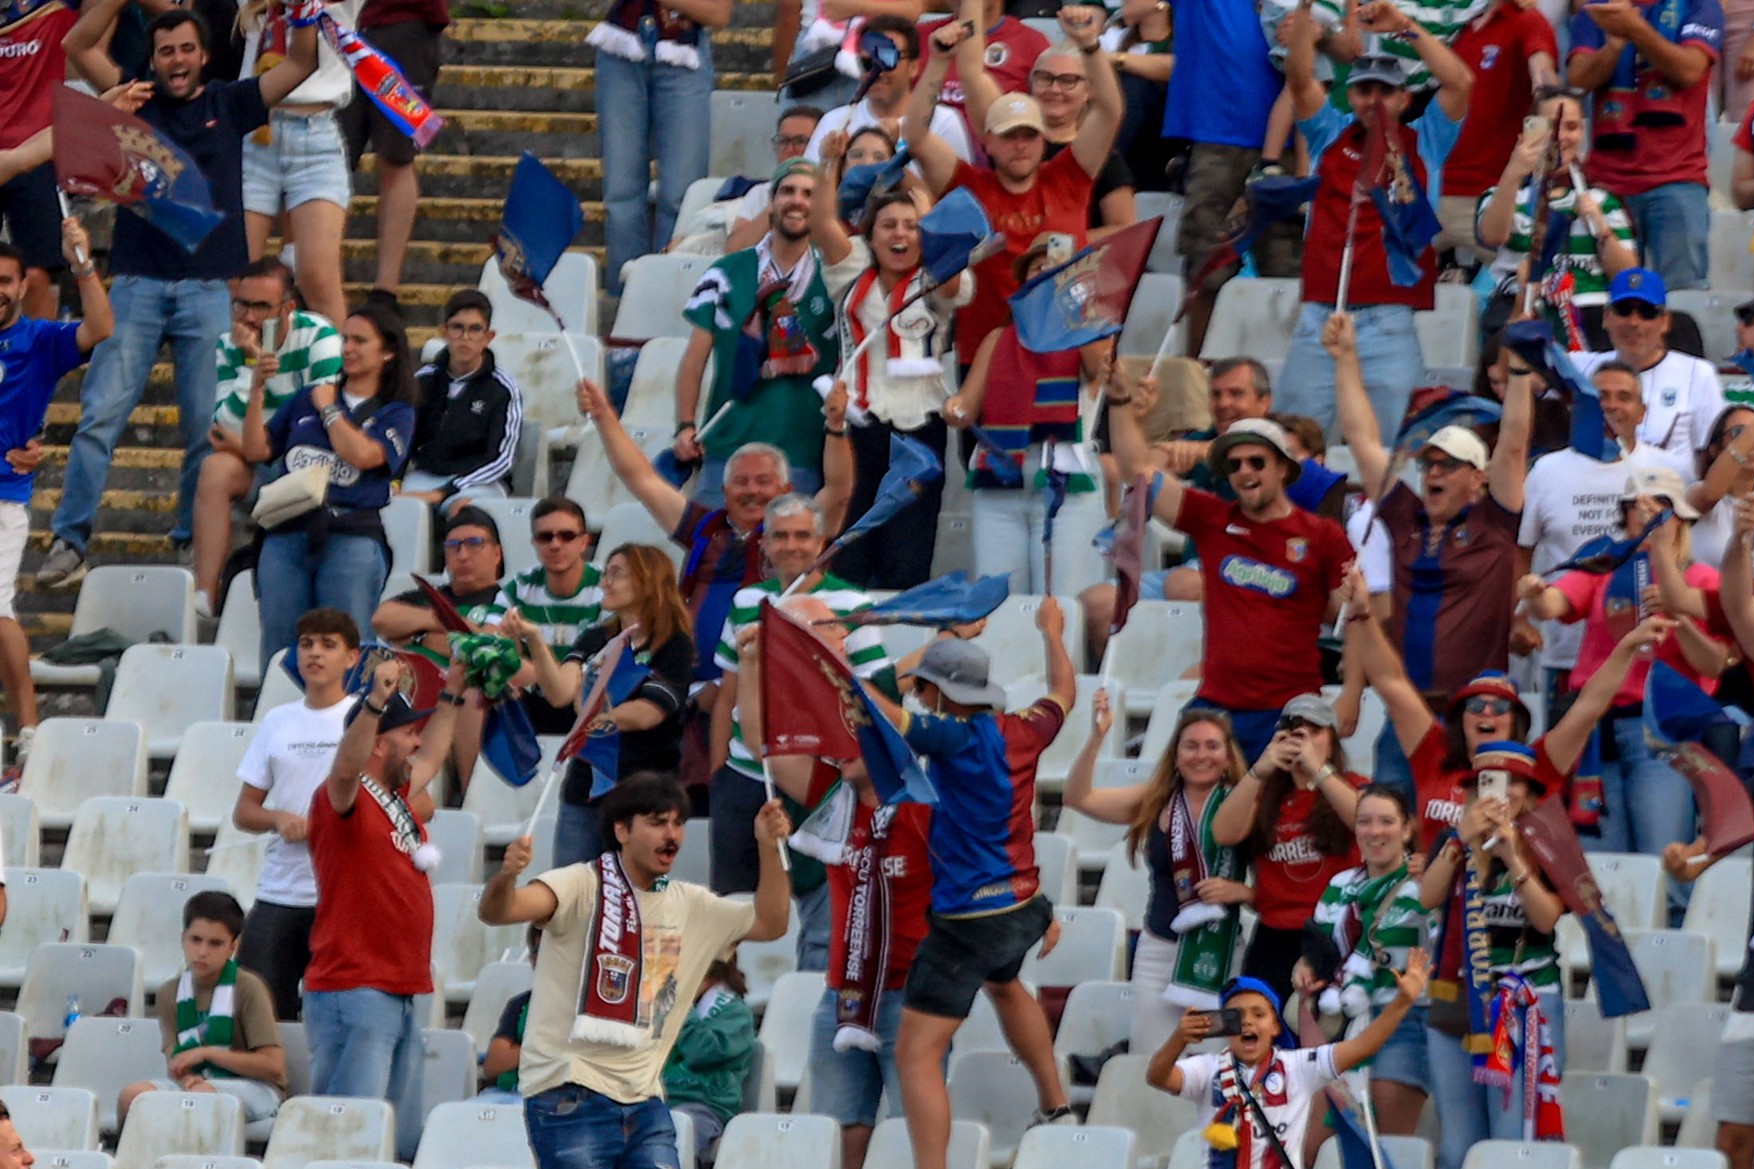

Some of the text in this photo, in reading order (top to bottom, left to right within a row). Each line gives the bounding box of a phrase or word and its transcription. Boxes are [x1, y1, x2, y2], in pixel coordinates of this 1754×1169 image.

[1579, 510, 1603, 521] NOT
[1571, 525, 1621, 538] EVERYO
[845, 846, 873, 981] SCU TORREENSE
